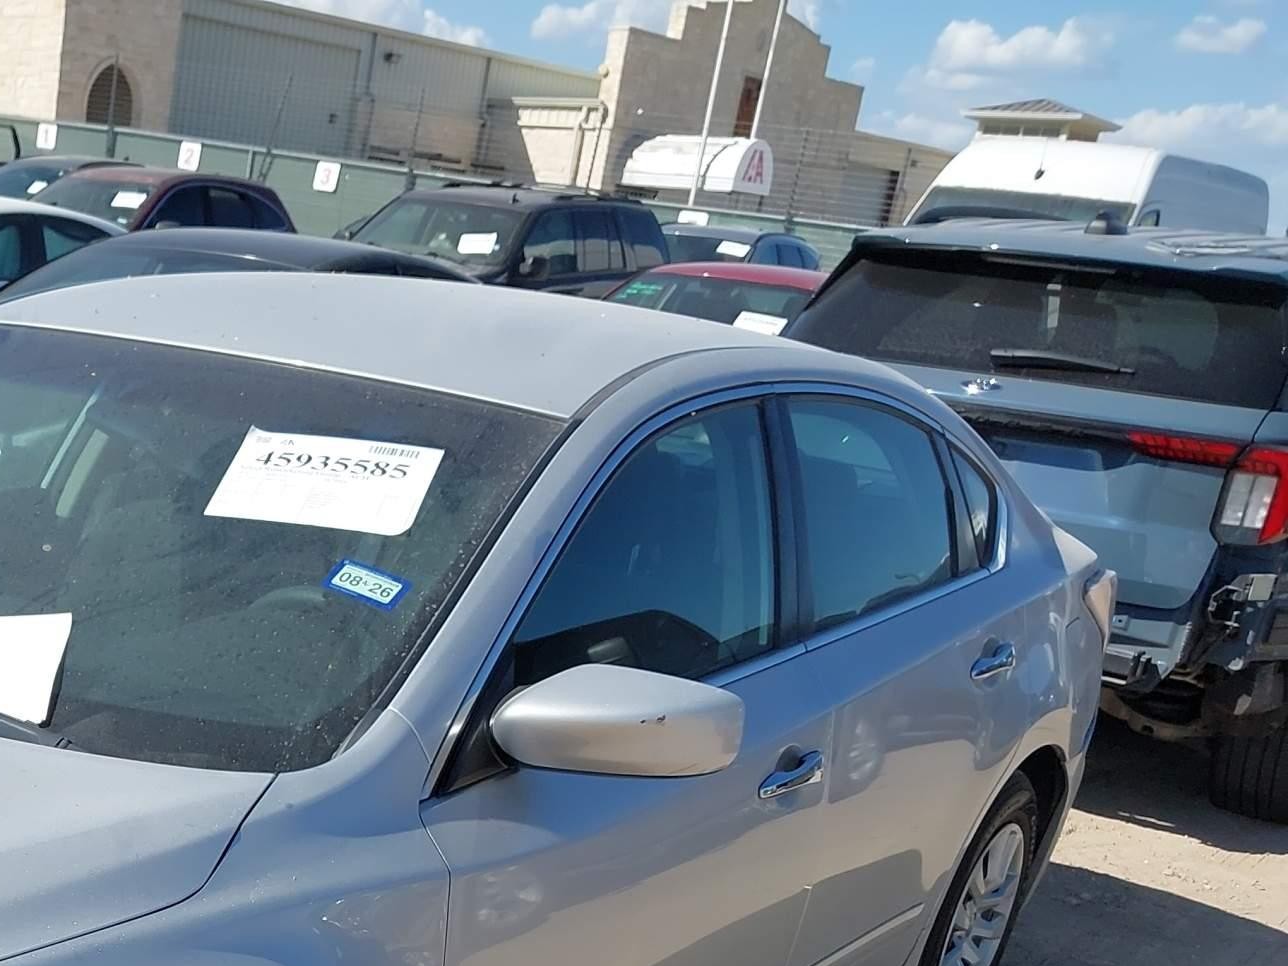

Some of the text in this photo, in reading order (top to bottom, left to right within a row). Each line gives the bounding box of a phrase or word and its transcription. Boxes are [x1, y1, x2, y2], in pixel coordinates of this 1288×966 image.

[320, 167, 332, 185] 3
[256, 451, 410, 479] 45935585
[368, 582, 394, 599] 26
